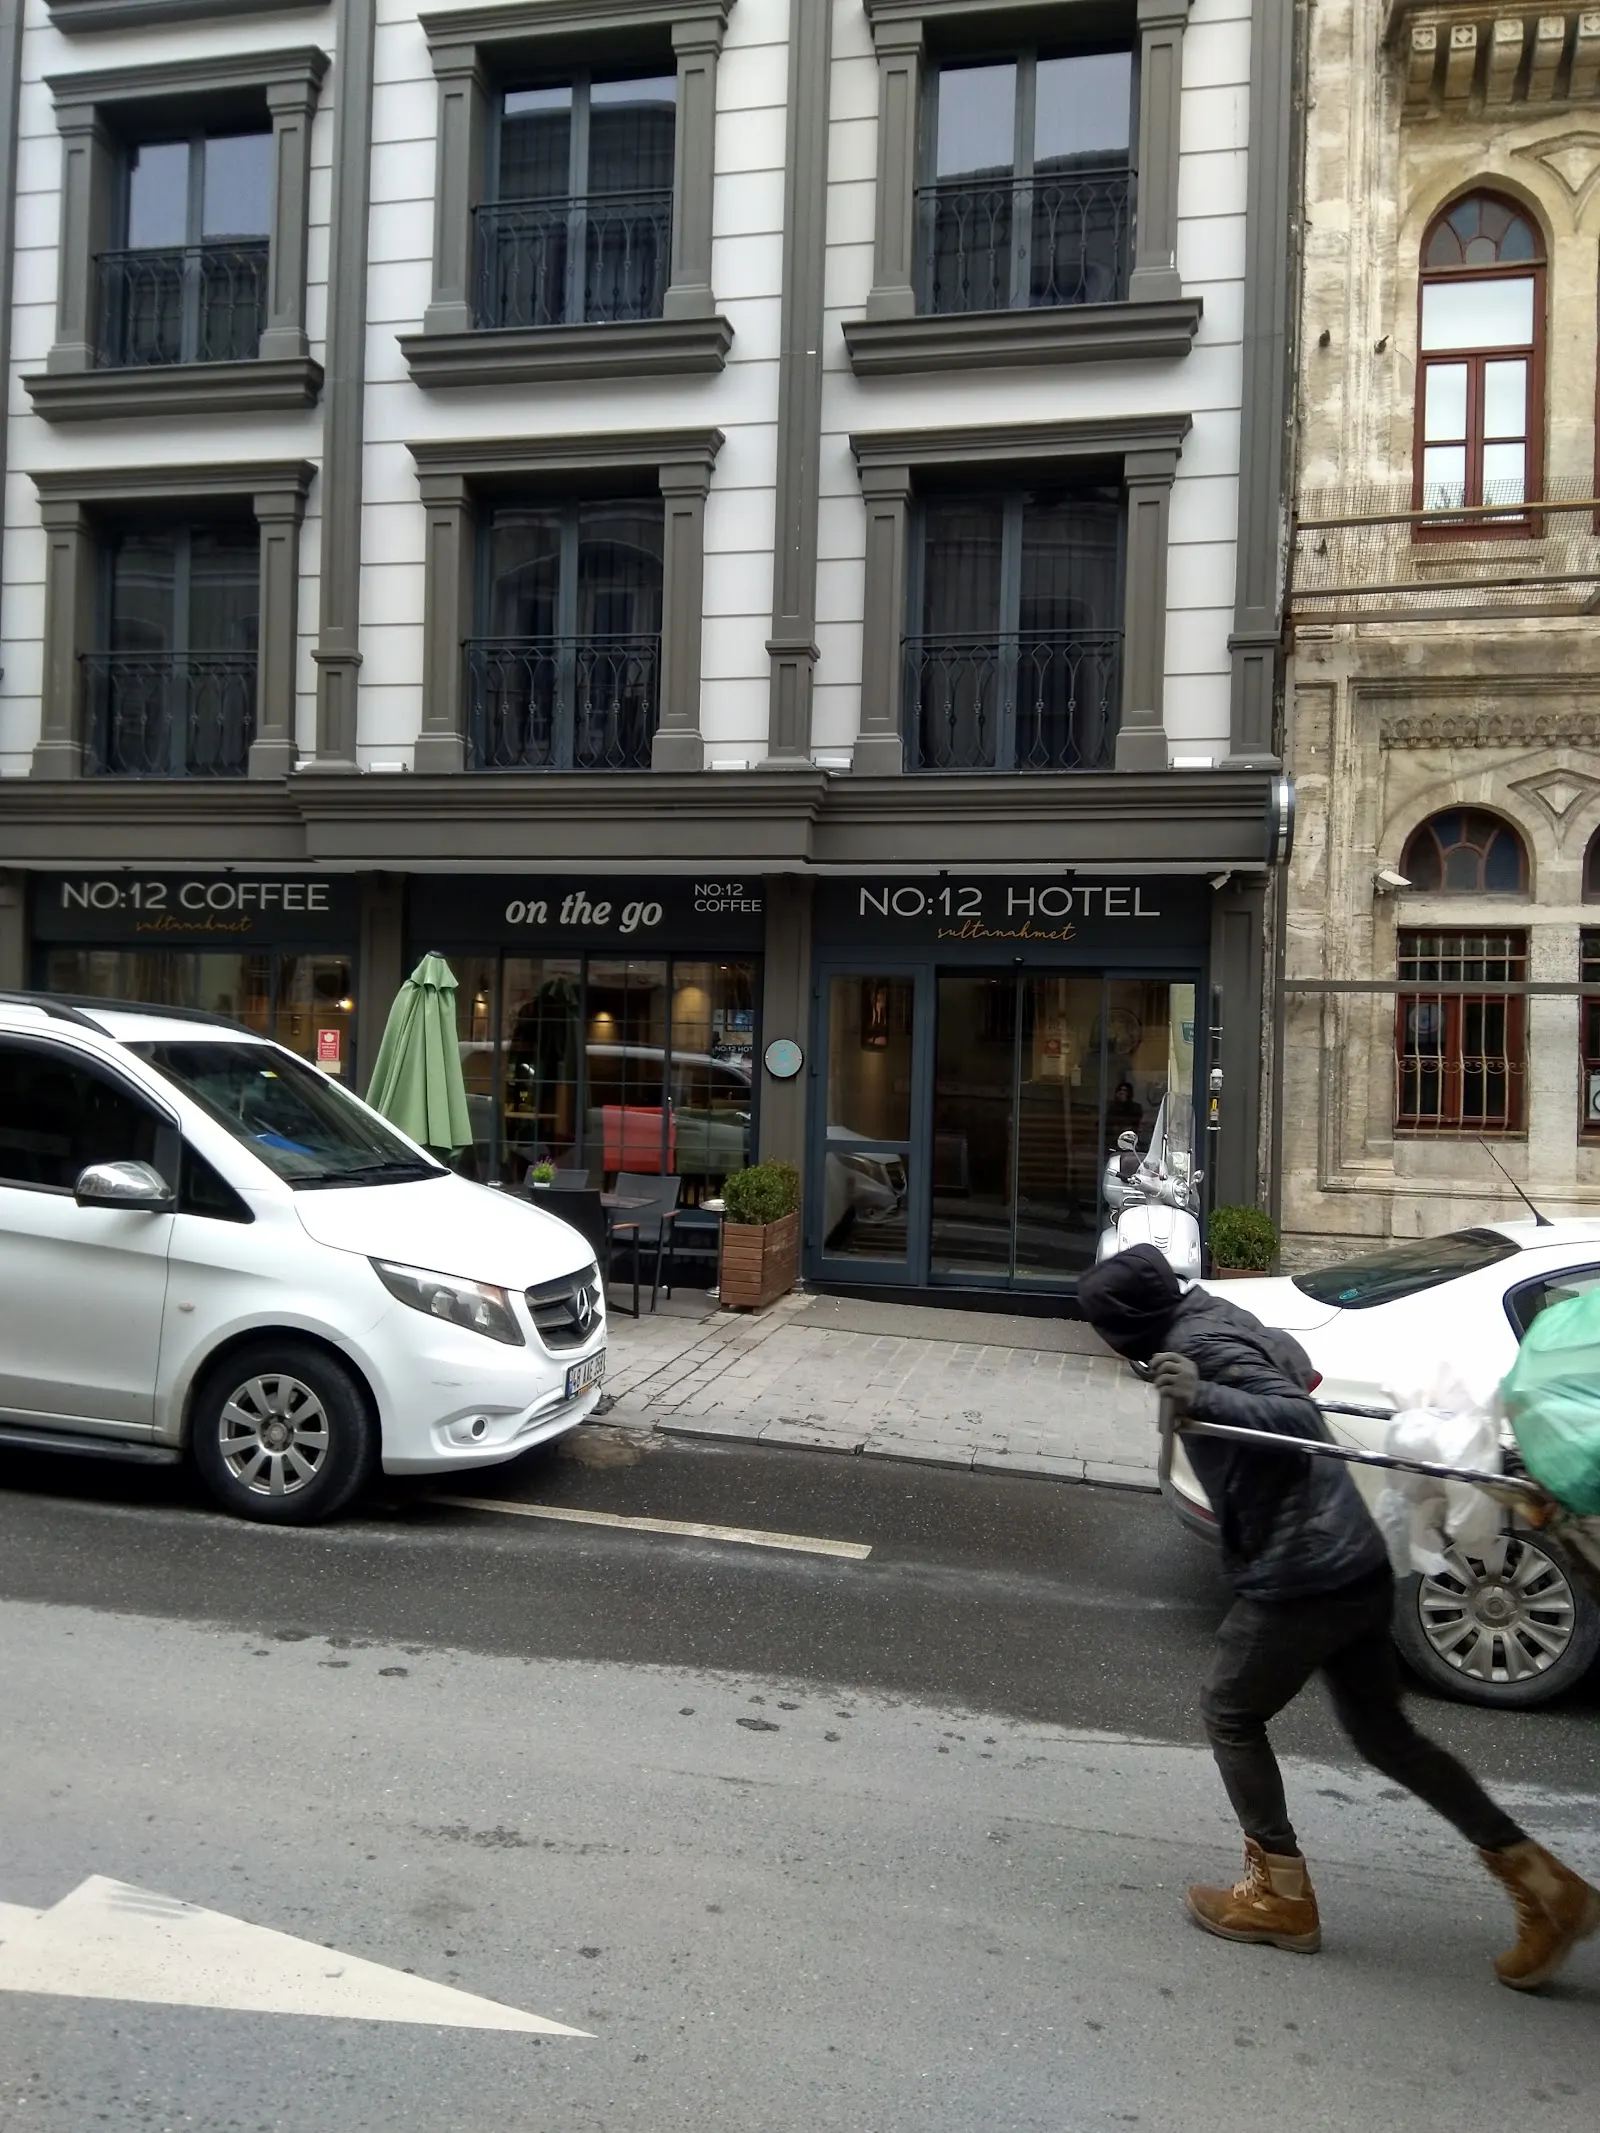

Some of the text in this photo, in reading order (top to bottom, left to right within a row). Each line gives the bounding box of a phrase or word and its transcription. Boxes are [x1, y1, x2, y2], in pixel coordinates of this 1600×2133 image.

[62, 881, 331, 912] NO:12 COFFEE
[694, 883, 744, 897] NO:12
[505, 890, 664, 934] on the go
[693, 899, 762, 913] COFFEE
[859, 886, 1162, 918] NO:12 HOTEL
[135, 913, 254, 934] sultanahmet
[936, 919, 1077, 941] sultanahmet
